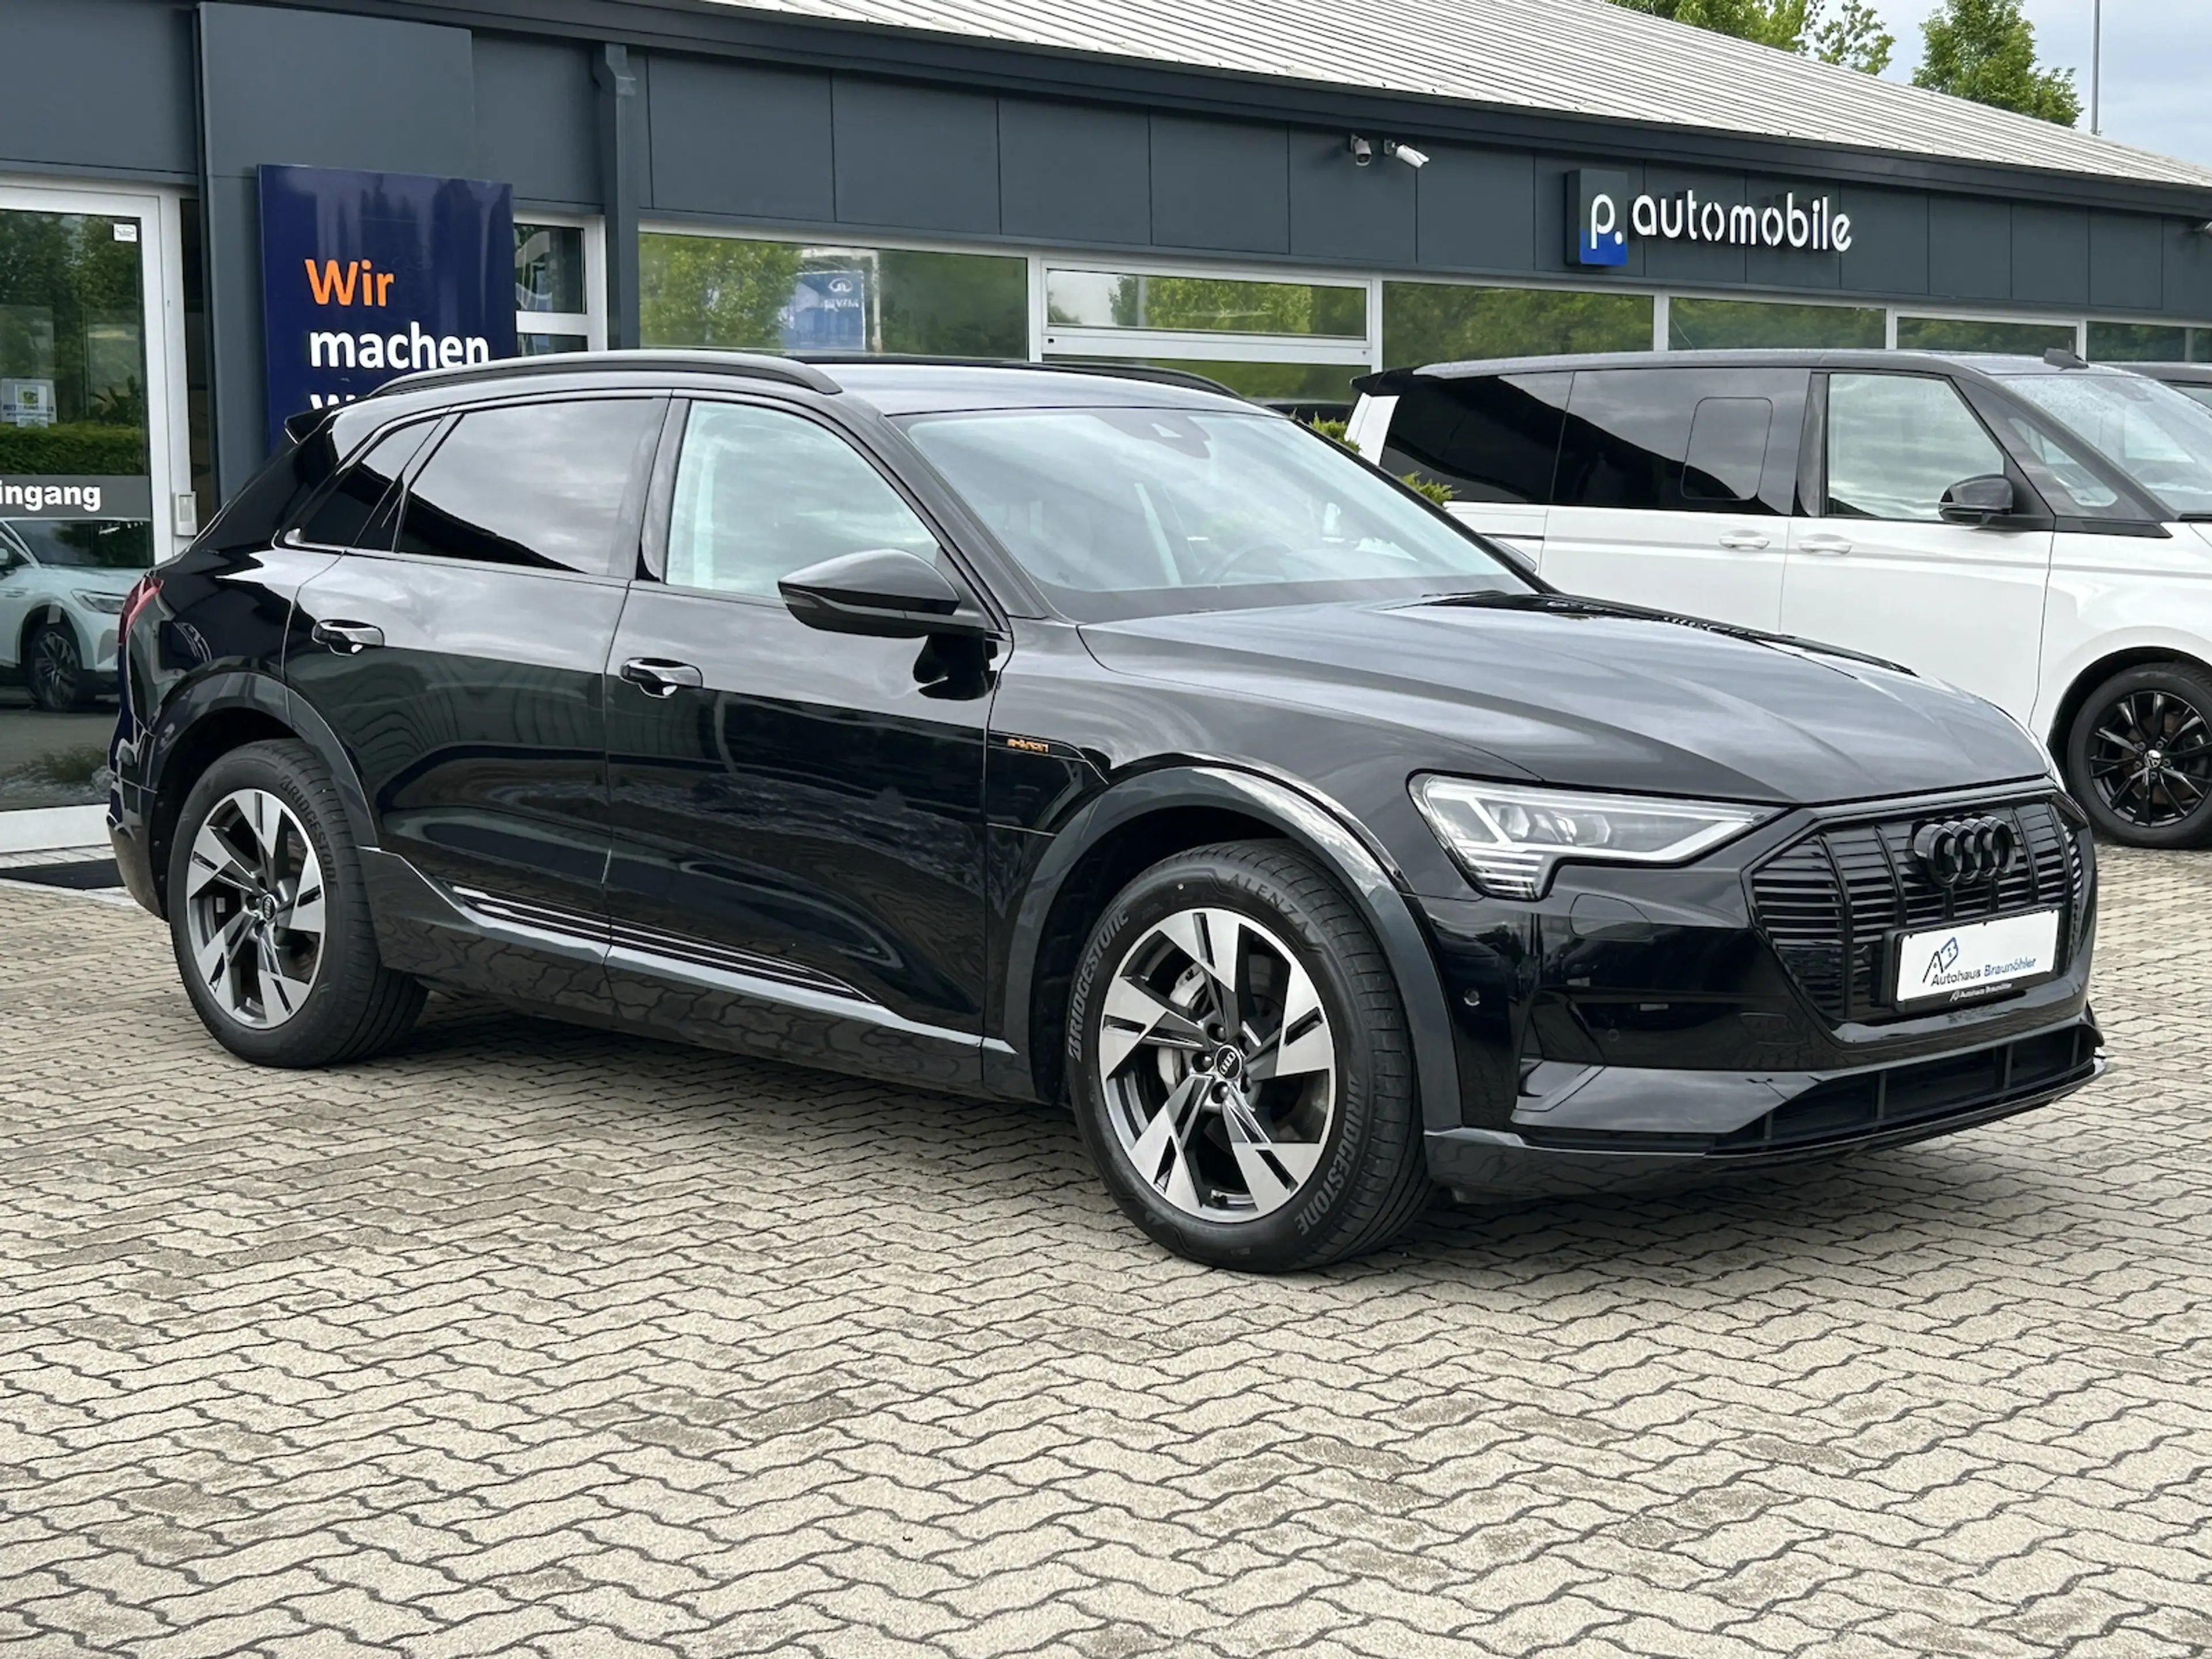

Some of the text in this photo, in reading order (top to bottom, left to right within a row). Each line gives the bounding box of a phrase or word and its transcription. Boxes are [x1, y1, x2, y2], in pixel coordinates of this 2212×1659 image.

[1633, 189, 1852, 252] automobile
[305, 259, 394, 306] Wir
[310, 321, 489, 369] machen
[1228, 873, 1308, 933] ALENZA
[1068, 910, 1128, 1062] BRIDGESTONE
[1930, 970, 1981, 986] Autohaus
